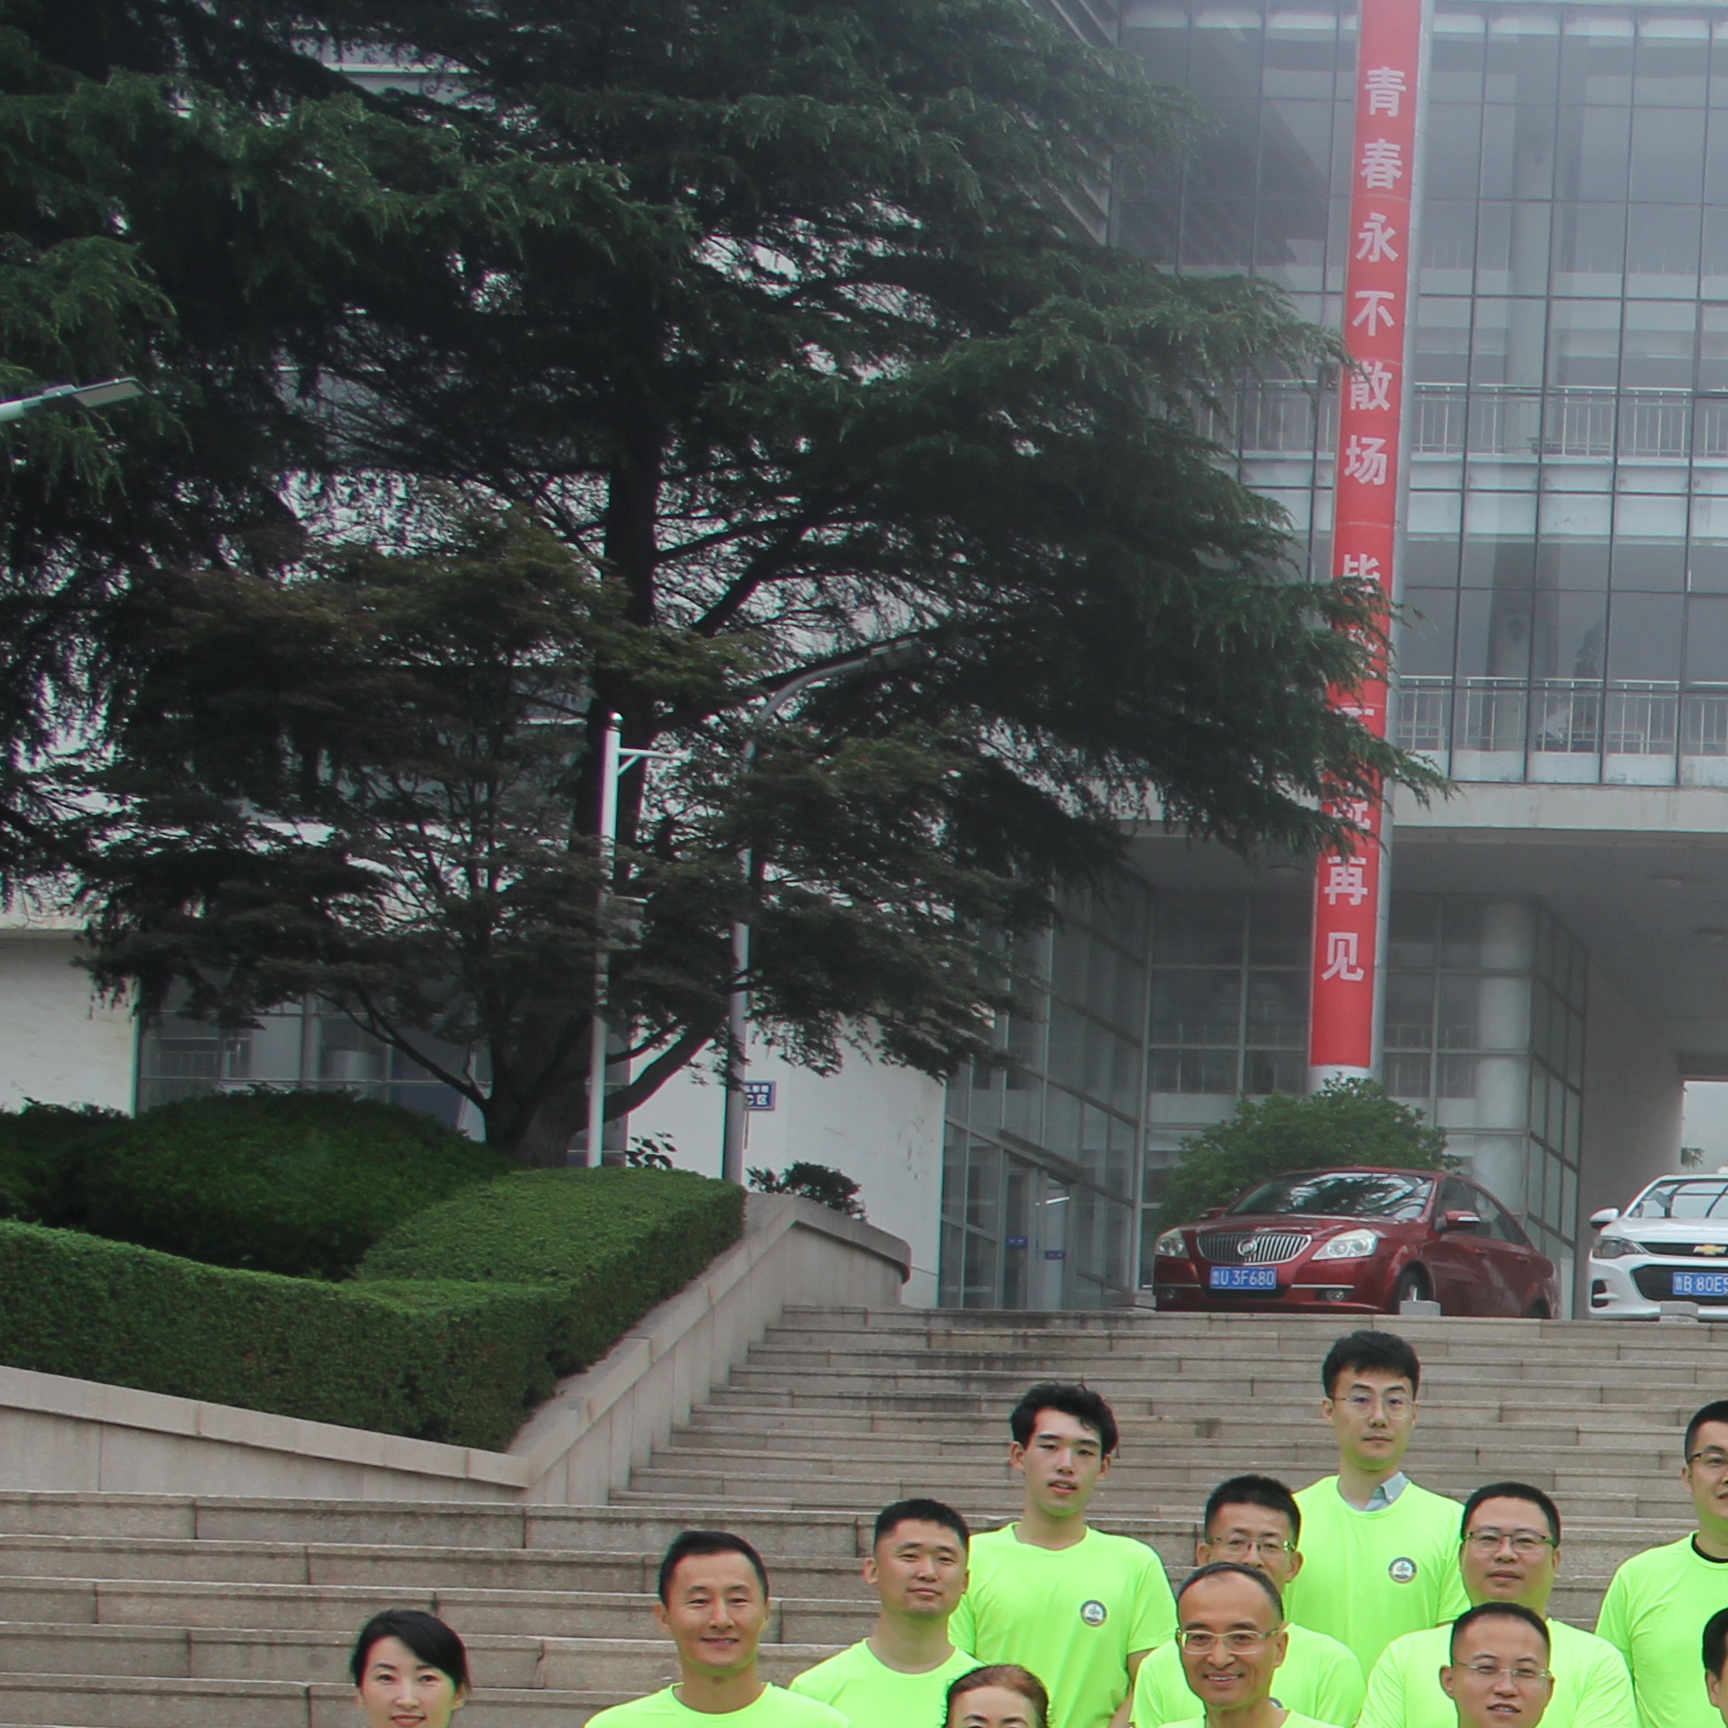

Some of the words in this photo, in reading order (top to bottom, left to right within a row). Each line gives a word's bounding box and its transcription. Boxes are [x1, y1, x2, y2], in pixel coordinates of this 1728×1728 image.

[1345, 66, 1406, 487] 青春永不散场
